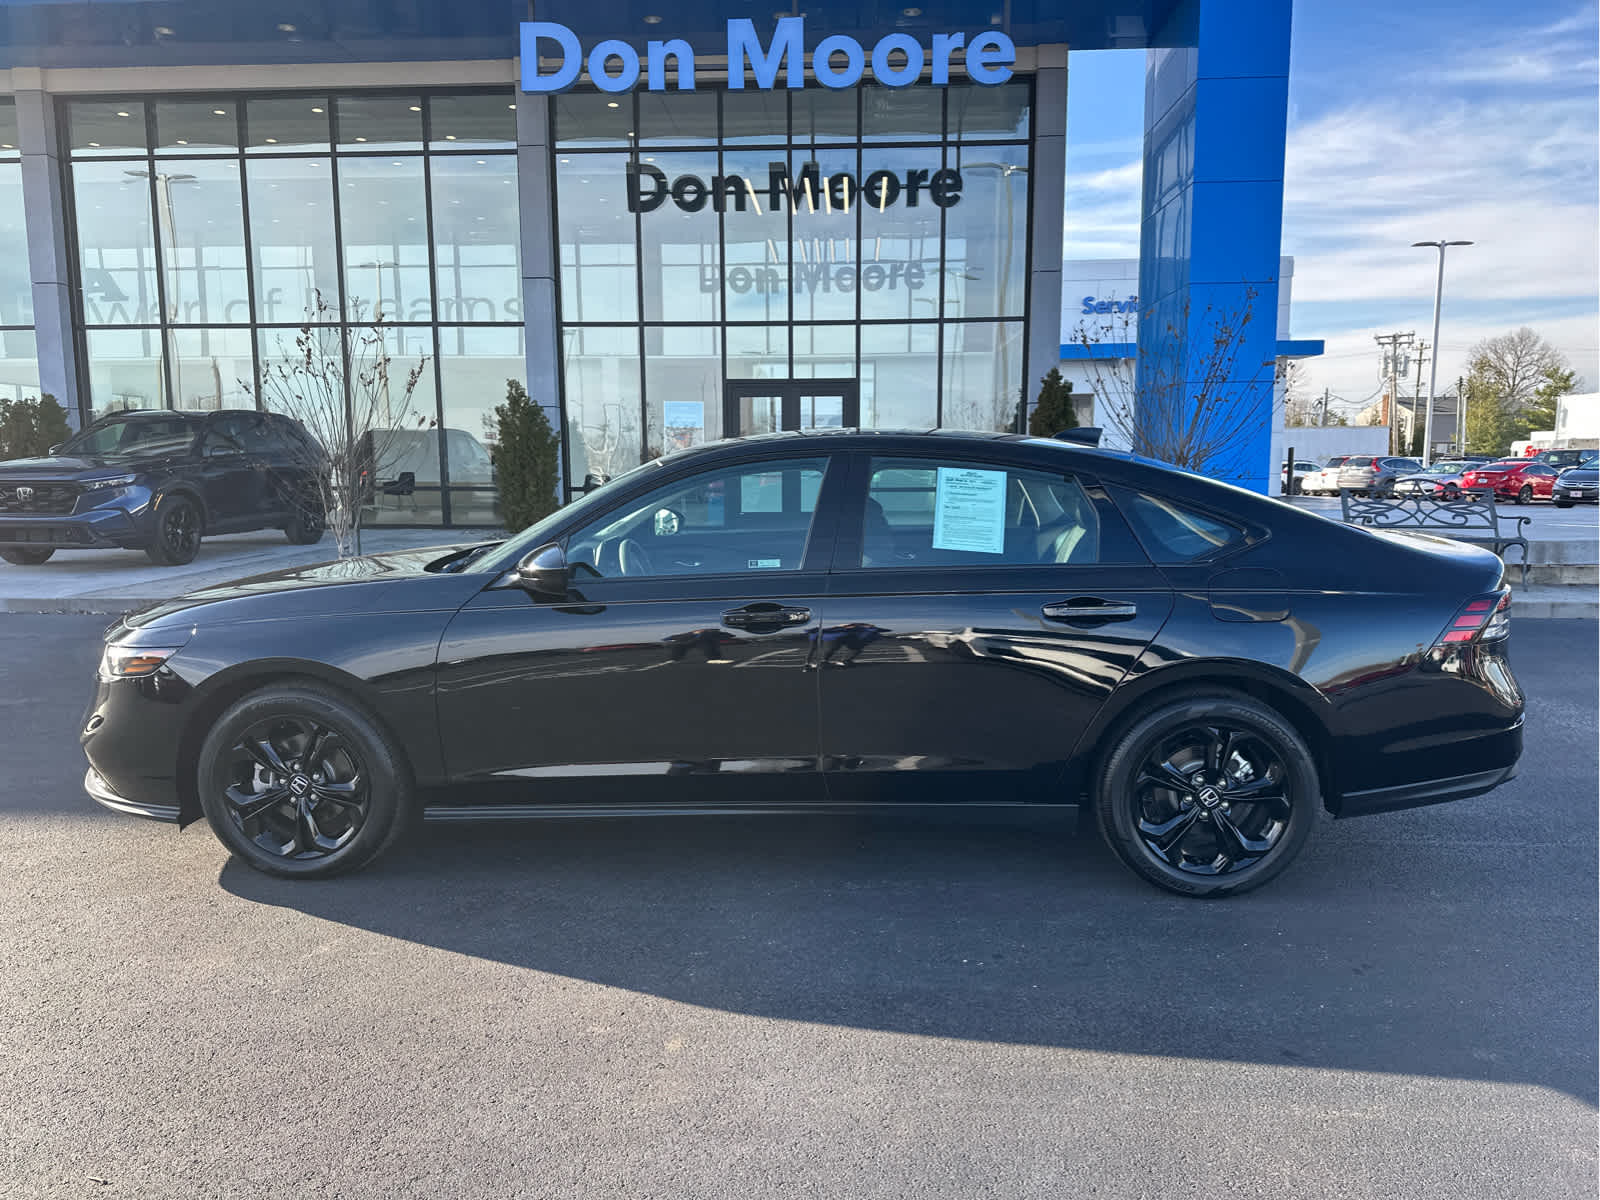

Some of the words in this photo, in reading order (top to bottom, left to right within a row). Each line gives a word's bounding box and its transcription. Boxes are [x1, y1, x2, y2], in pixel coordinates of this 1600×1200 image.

[519, 21, 696, 94] Don
[727, 16, 1016, 90] Moore
[626, 161, 747, 213] Don
[768, 160, 963, 210] Moore
[1081, 296, 1139, 315] Servi
